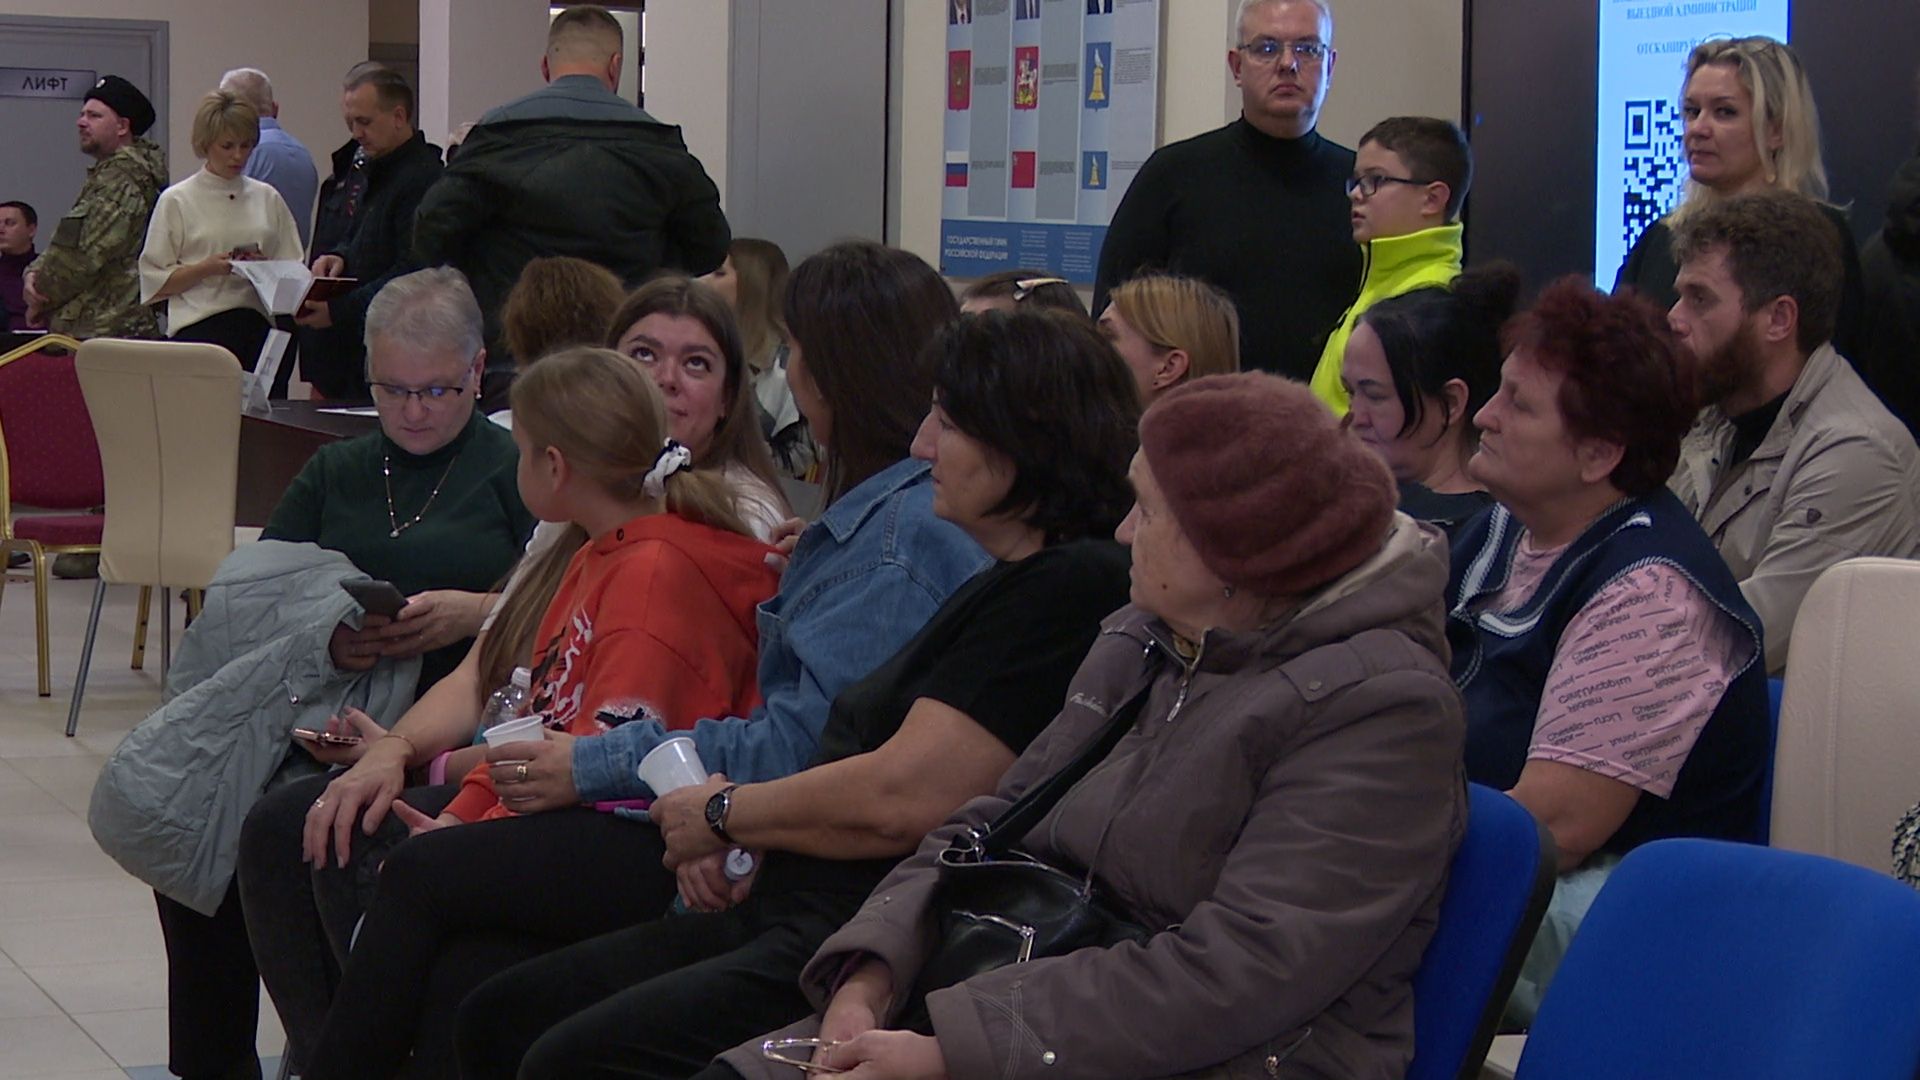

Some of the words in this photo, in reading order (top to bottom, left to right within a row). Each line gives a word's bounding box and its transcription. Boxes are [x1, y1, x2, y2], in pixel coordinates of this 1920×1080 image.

[1627, 6, 1674, 20] ВЫЕЗДНОЙ
[1676, 0, 1757, 17] АДМИНИСТРАЦИИ
[22, 76, 68, 91] ЛИФТ
